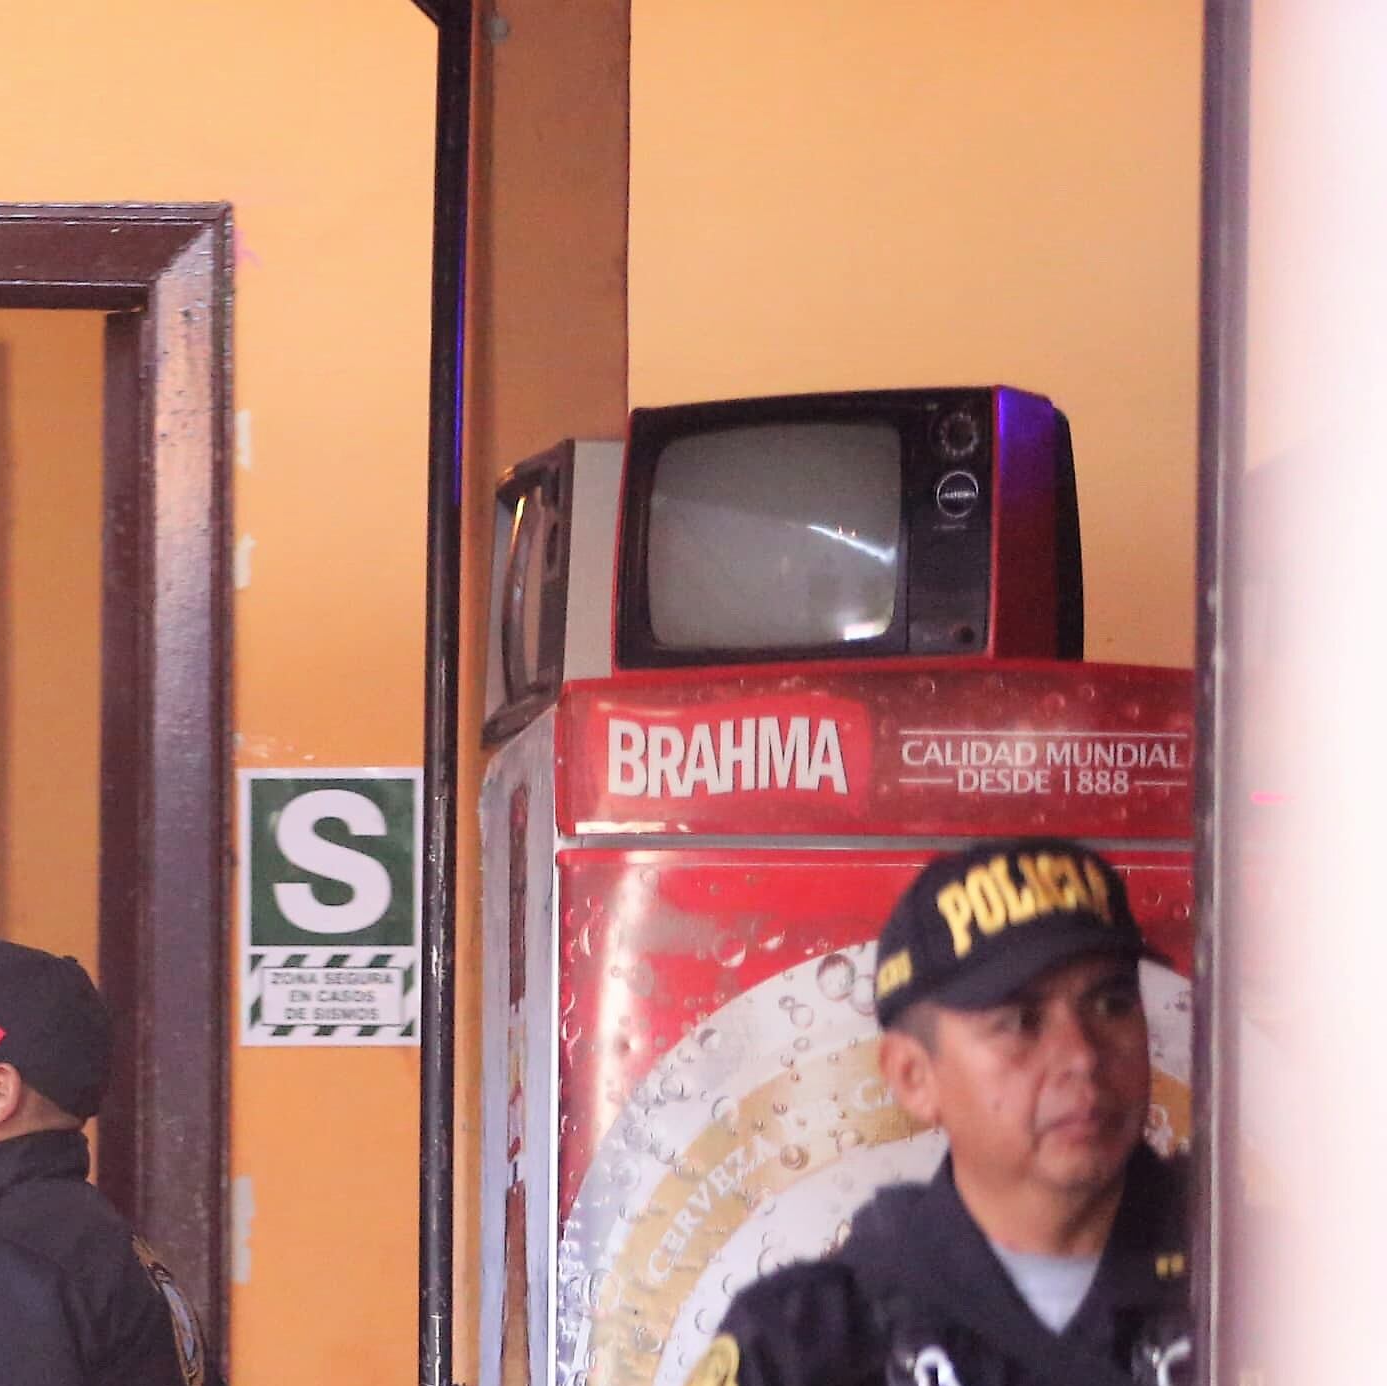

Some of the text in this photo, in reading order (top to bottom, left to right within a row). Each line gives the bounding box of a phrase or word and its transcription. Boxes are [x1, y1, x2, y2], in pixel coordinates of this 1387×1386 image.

[607, 715, 848, 798] BRAHMA
[901, 740, 1183, 769] CALIDAD MUNDIAL
[957, 767, 1129, 794] DESDE 1888
[273, 788, 392, 934] S
[270, 972, 394, 985] ZONA SEGURA
[290, 990, 375, 1002] EN CASOS
[285, 1007, 379, 1020] DE SISMOS
